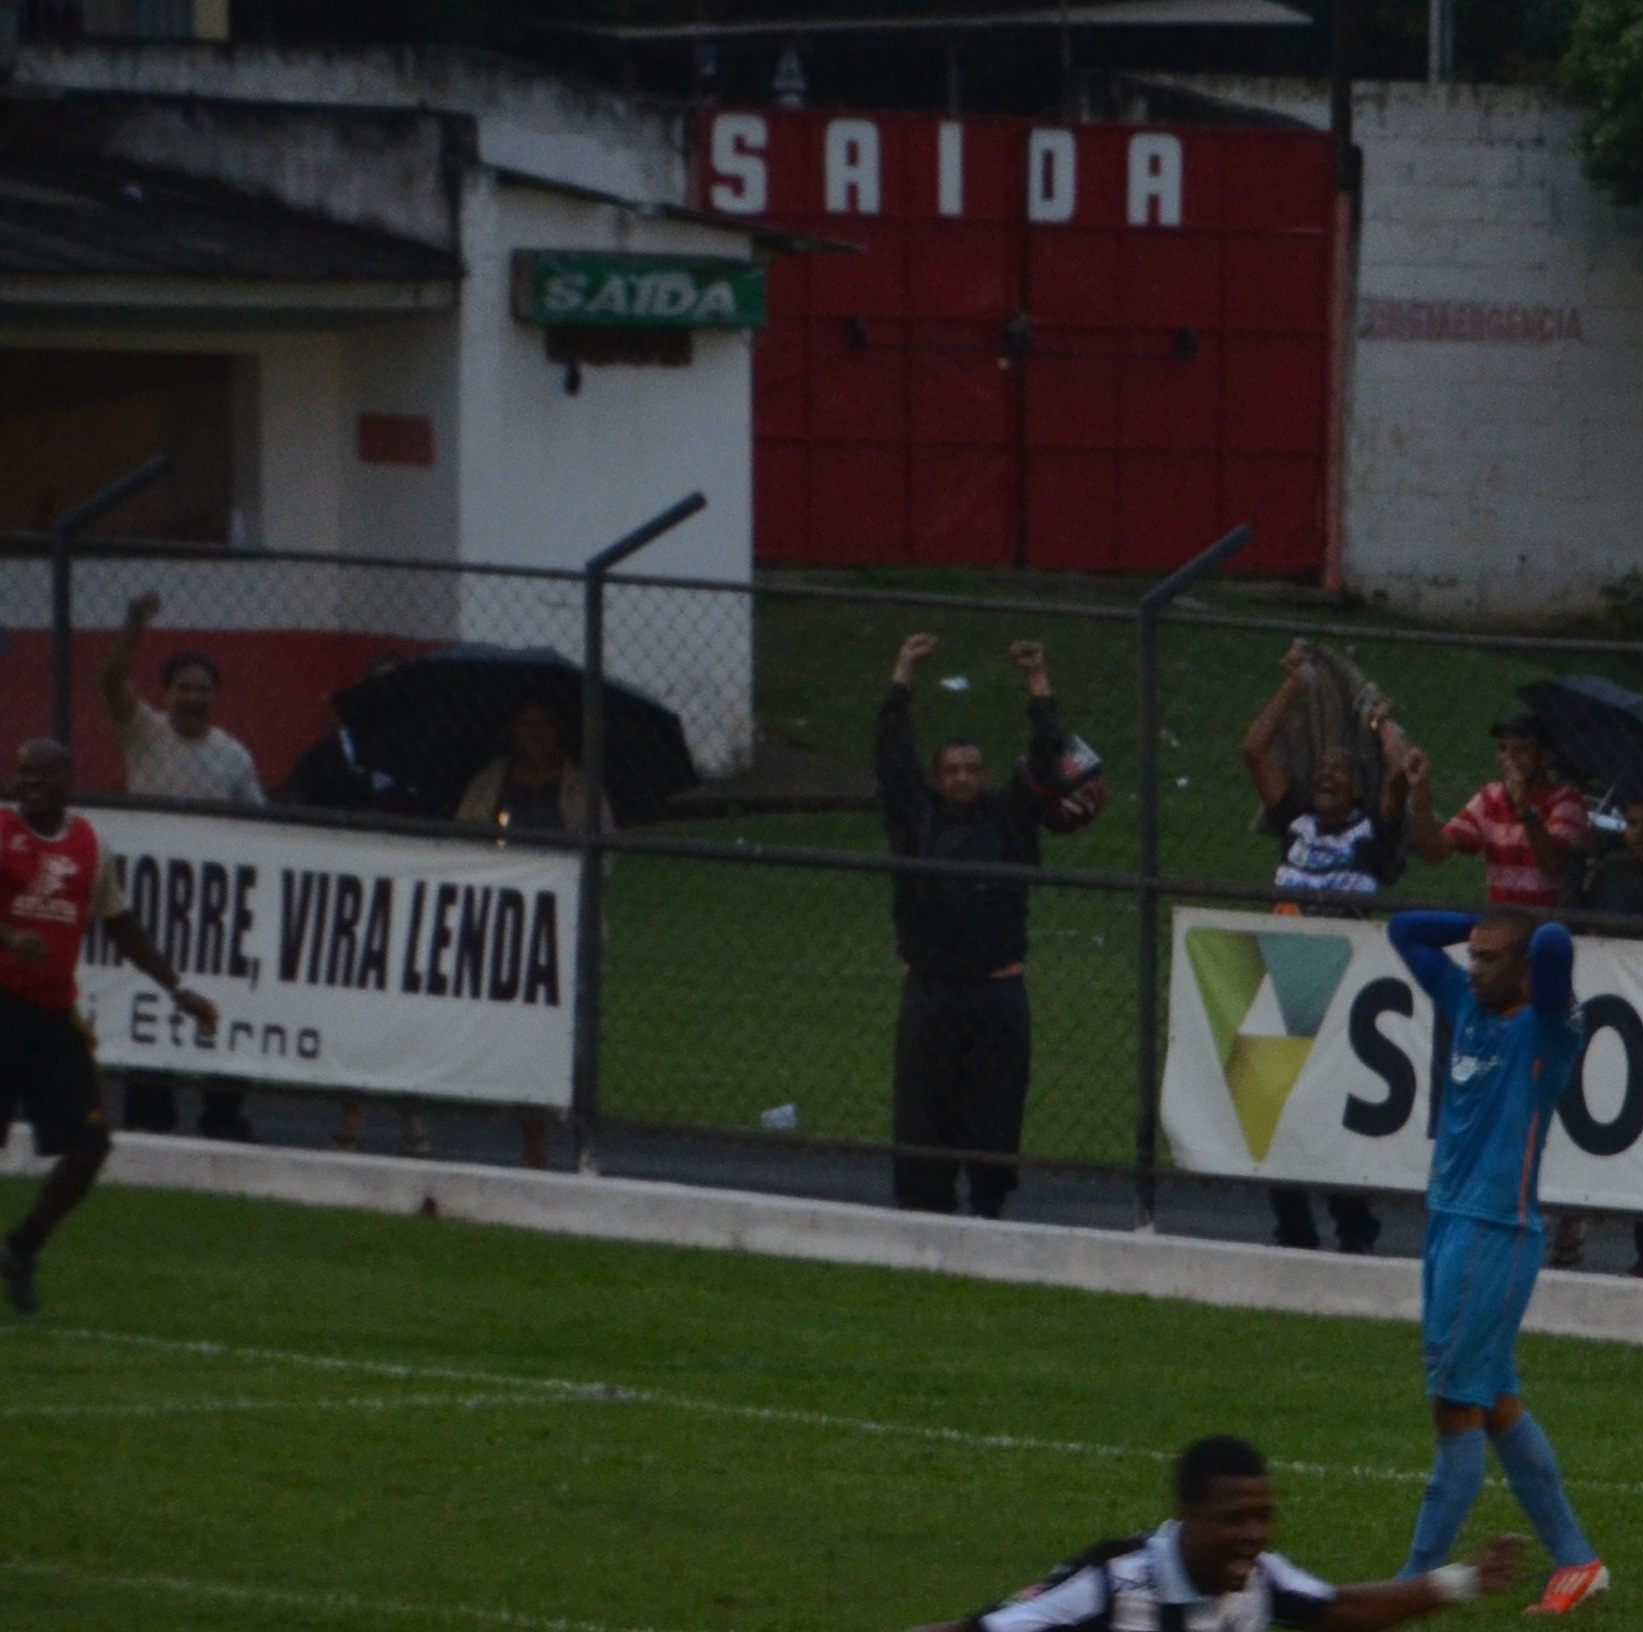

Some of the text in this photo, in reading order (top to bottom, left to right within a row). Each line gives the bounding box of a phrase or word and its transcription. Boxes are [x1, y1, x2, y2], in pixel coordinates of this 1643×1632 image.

[711, 112, 1183, 228] SAIDA
[279, 867, 393, 992] VIRA
[402, 880, 561, 1008] LENDA
